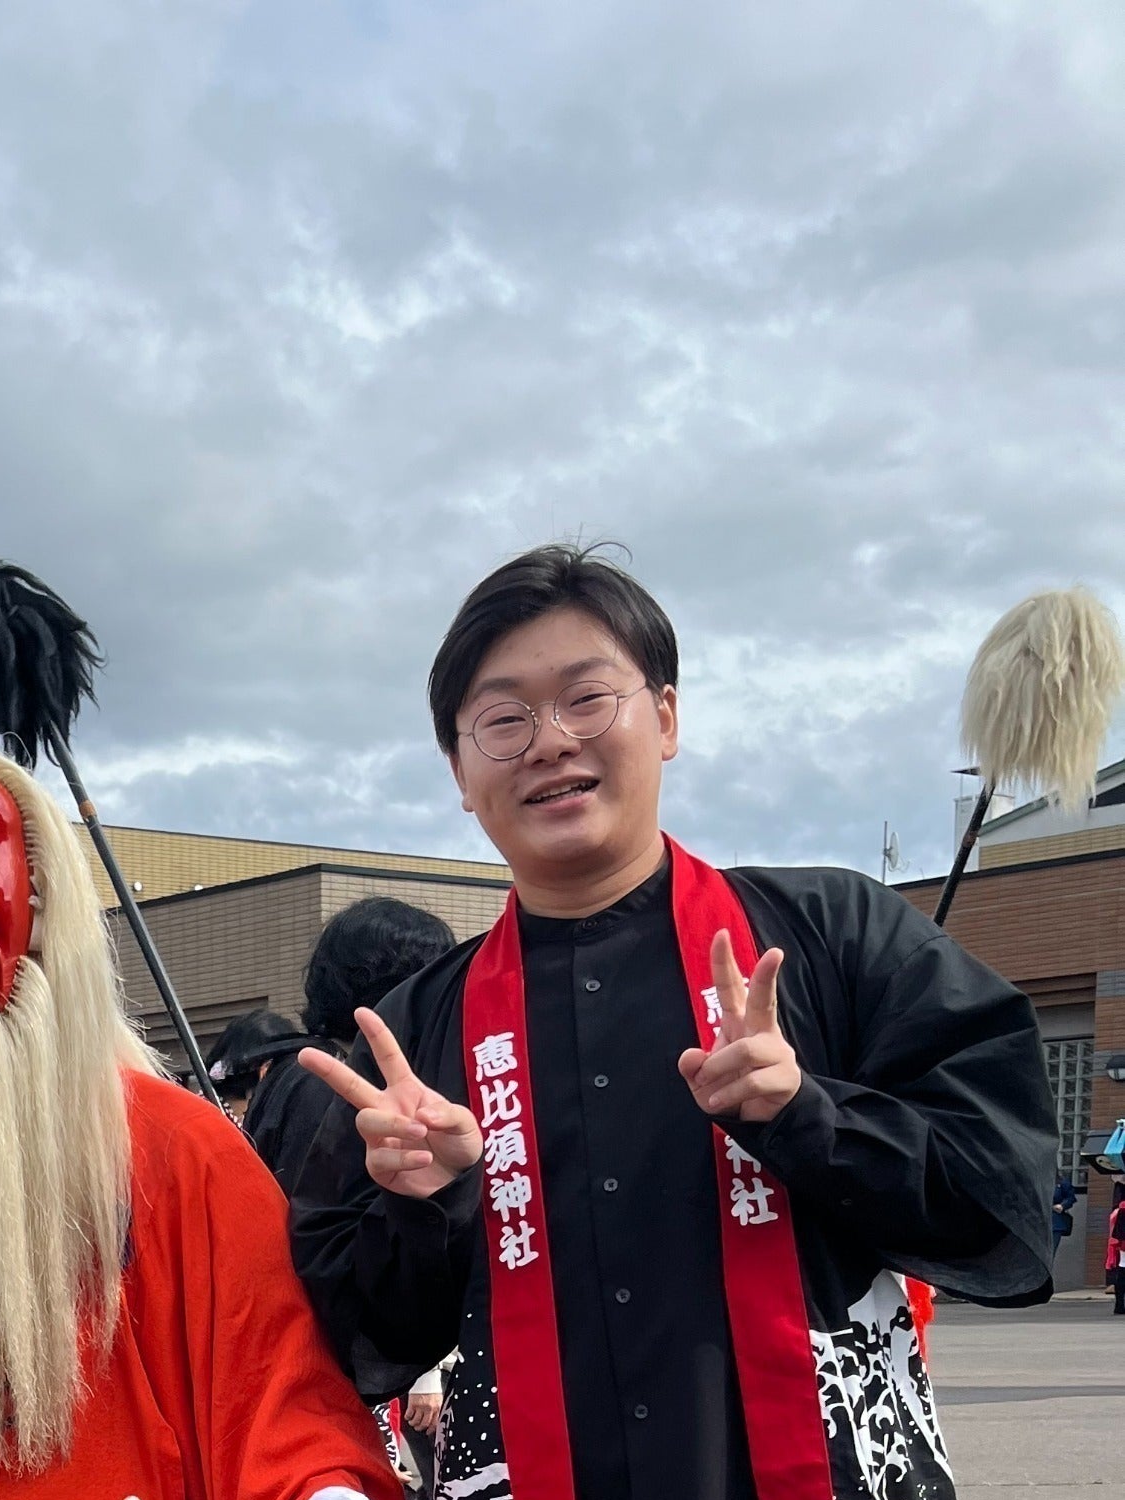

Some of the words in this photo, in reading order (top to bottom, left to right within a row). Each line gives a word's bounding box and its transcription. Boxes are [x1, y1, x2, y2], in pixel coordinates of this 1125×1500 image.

[472, 1031, 540, 1271] 恵比須神社
